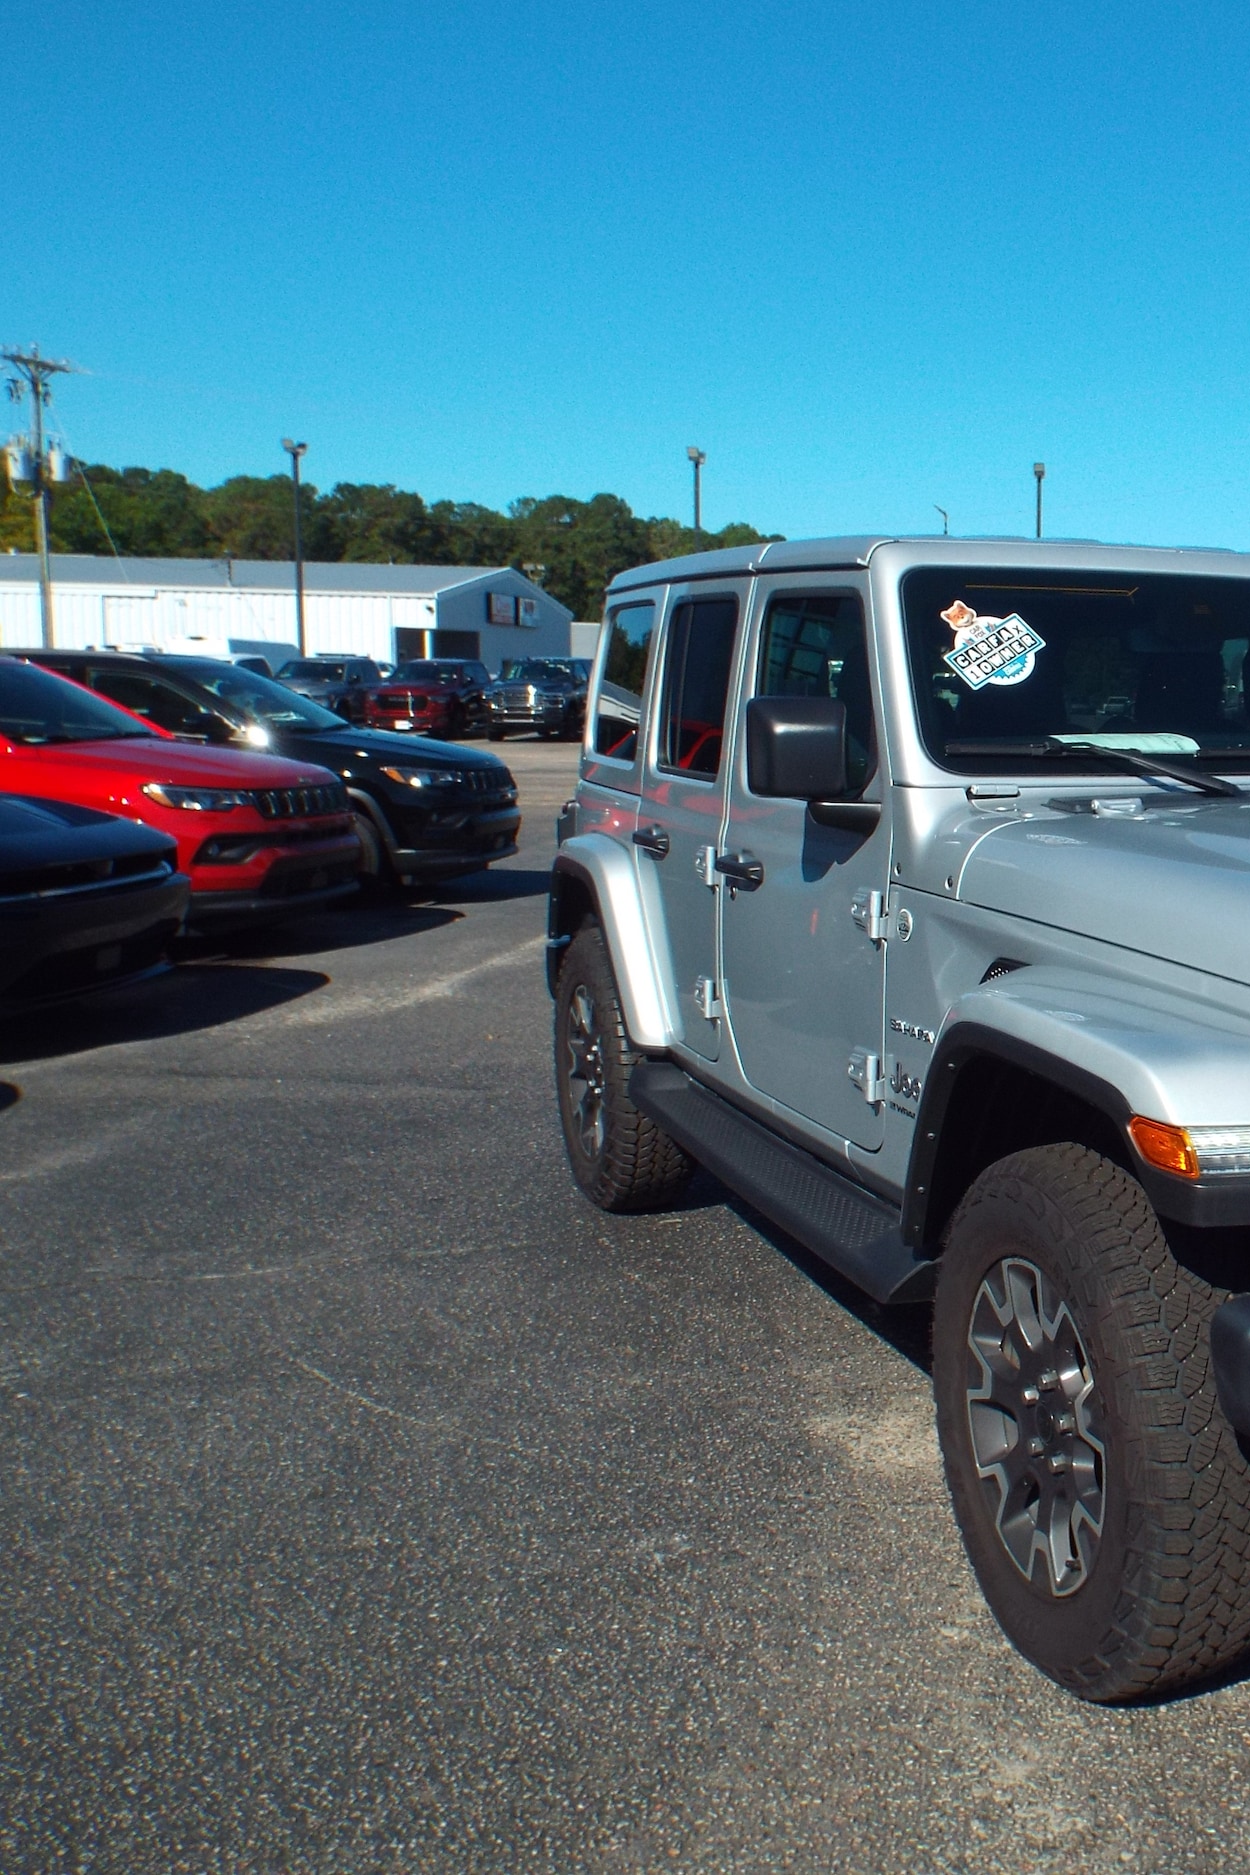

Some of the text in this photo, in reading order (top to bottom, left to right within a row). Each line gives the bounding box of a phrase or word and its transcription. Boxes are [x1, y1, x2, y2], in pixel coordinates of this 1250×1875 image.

[953, 625, 1023, 669] CARFAX
[970, 670, 981, 680] 1
[977, 633, 1038, 675] OWNER
[890, 1018, 935, 1044] SAHARA
[890, 1061, 922, 1103] Jee
